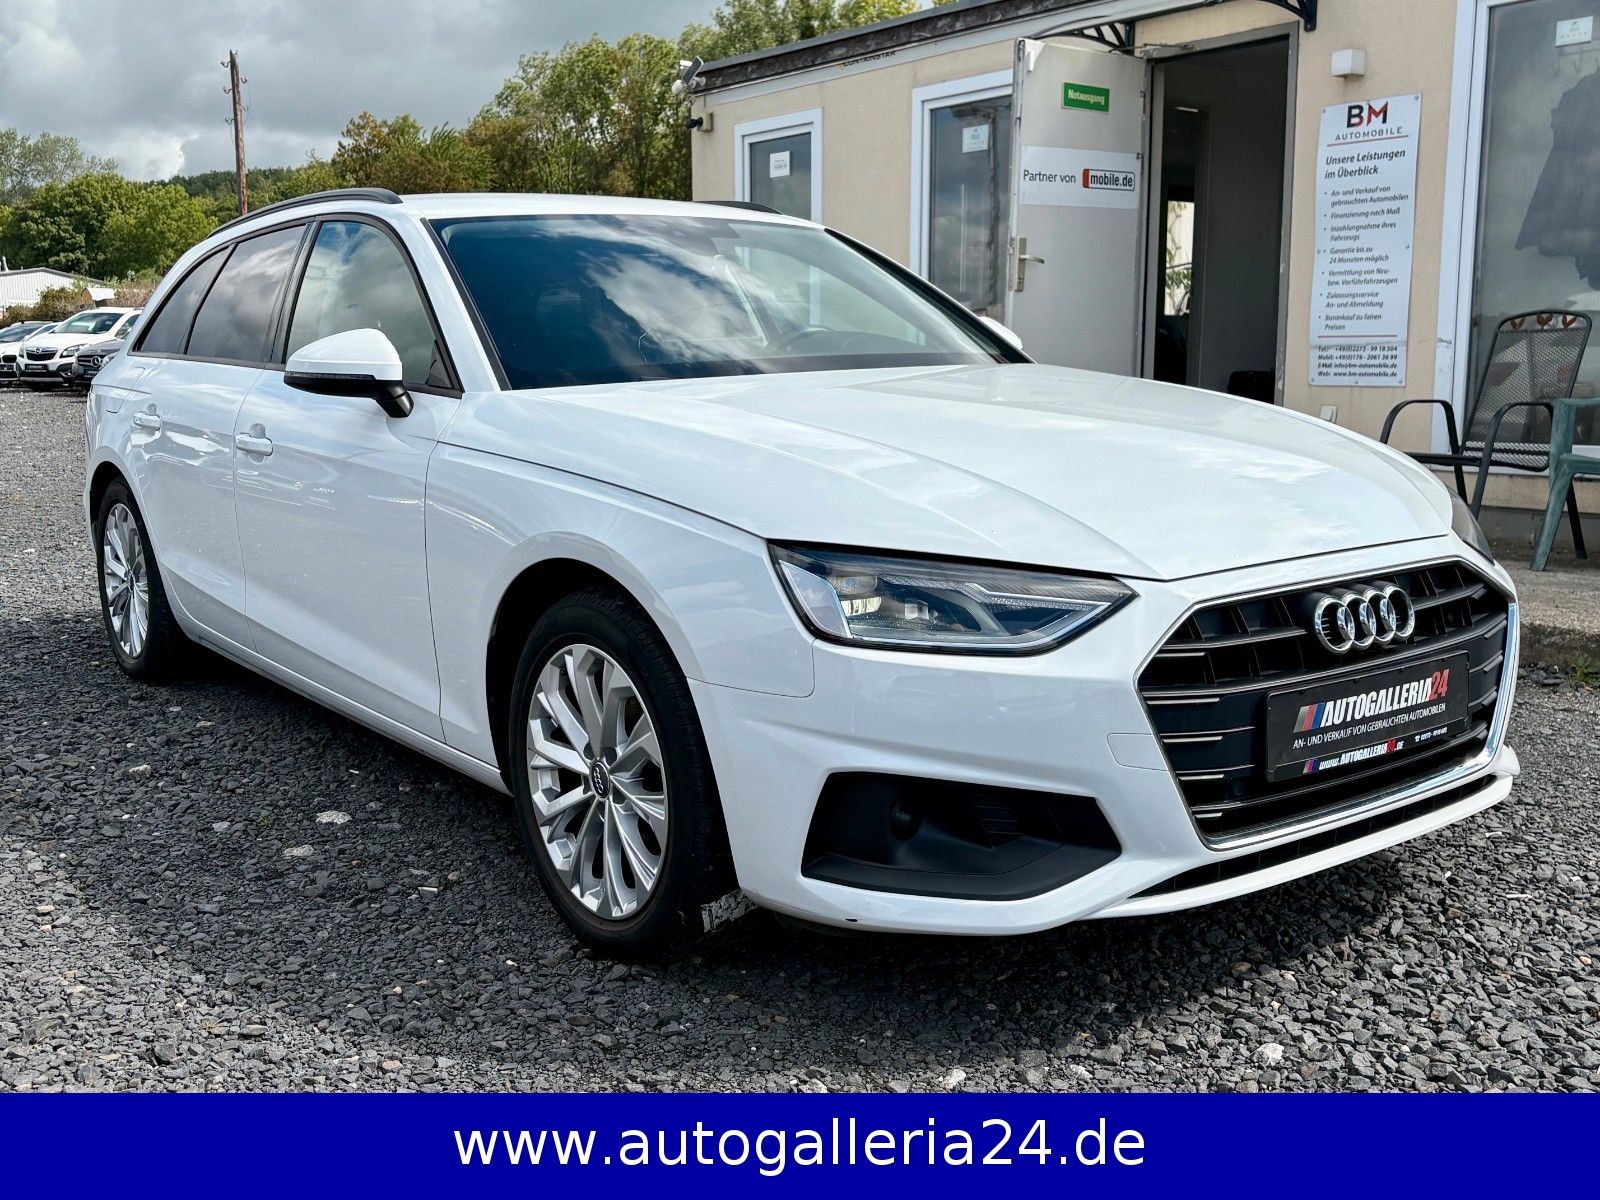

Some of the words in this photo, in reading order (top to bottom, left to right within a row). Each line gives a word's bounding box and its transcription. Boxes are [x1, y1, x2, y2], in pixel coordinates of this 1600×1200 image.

[1067, 89, 1105, 106] Notausgang
[1346, 100, 1389, 128] BM
[1335, 126, 1403, 141] AUTOMOBILE
[1326, 156, 1355, 165] Unsere
[1356, 150, 1406, 161] Leistungen
[1023, 169, 1058, 183] Partner
[1059, 175, 1076, 184] von
[1090, 172, 1133, 187] mobile.de
[1325, 169, 1336, 179] im
[1337, 165, 1379, 178] Überblick
[1342, 188, 1354, 196] und
[1355, 185, 1379, 195] Verkauf
[1330, 197, 1368, 208] gebrauchten
[1369, 194, 1409, 204] Automobilen
[1330, 210, 1370, 219] Finanzierung
[1370, 208, 1385, 217] nach
[1329, 247, 1355, 255] Garantie
[1337, 256, 1364, 264] Monaten
[1364, 254, 1389, 263] möglich
[1328, 269, 1363, 277] Vermittlung
[1319, 669, 1450, 728] AUTOGALLERIA24
[1293, 739, 1307, 750] AN-
[1307, 735, 1323, 747] UND
[1323, 727, 1353, 743] VERKAUF
[1352, 724, 1367, 736] VON
[1367, 713, 1409, 732] GEBRAUCHTEN
[1408, 703, 1446, 720] AUTOMOBILEN
